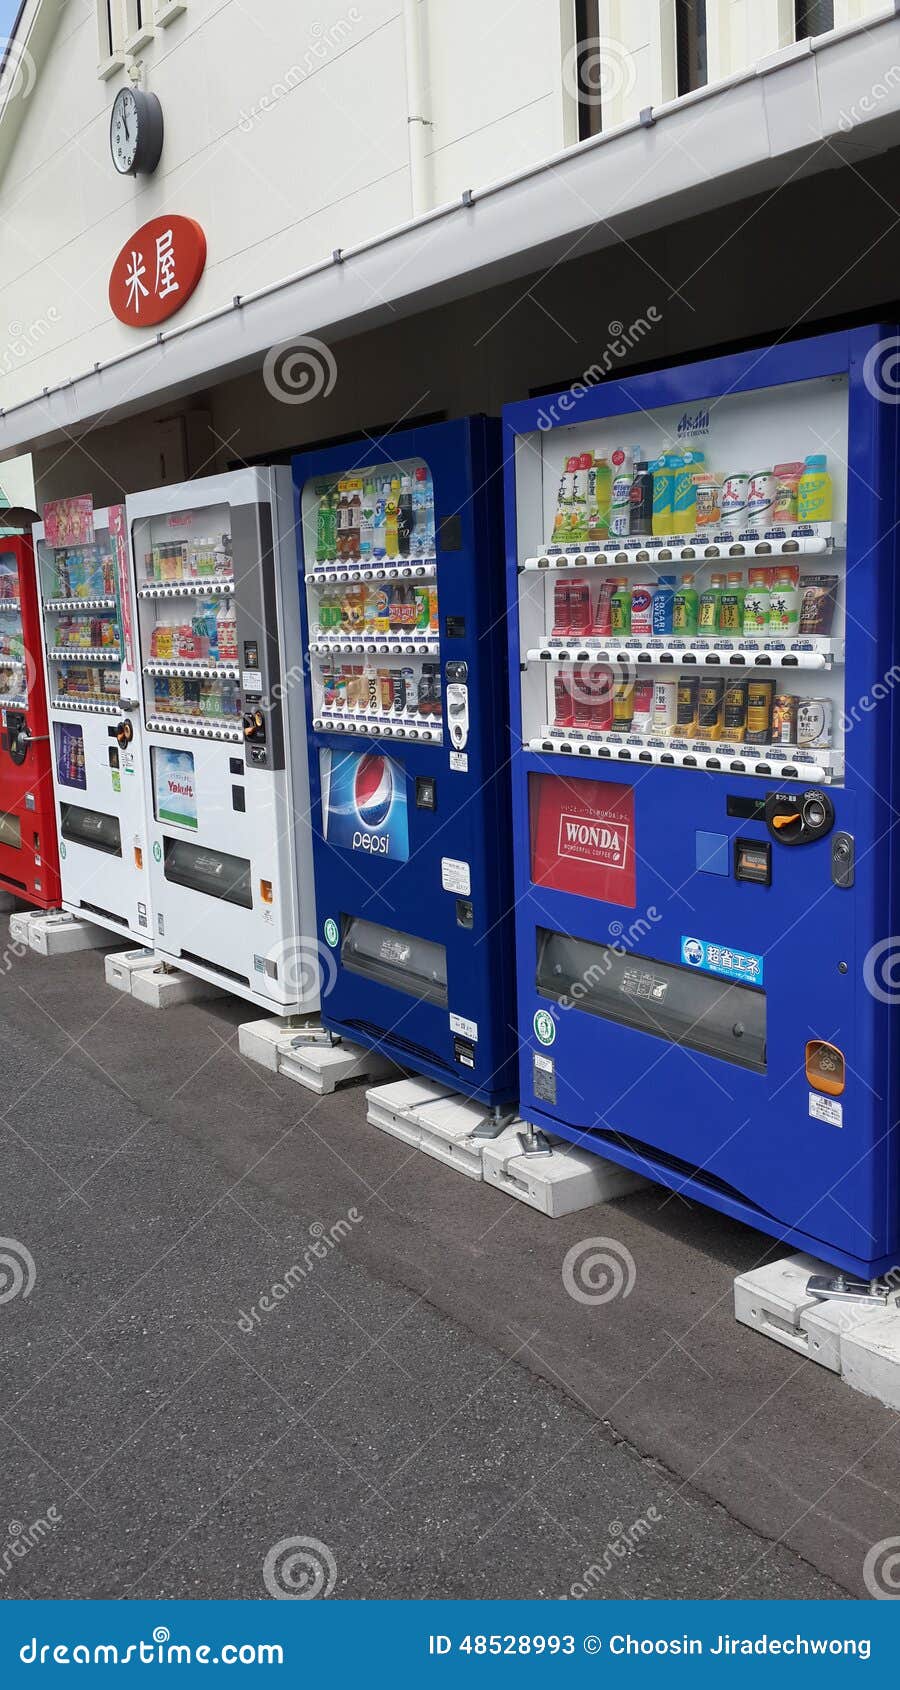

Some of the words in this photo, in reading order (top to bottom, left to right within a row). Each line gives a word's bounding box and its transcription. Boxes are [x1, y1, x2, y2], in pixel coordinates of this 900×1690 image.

[125, 229, 180, 314] 米屋
[677, 409, 710, 432] Asahi
[368, 679, 377, 708] BOSS
[168, 780, 193, 798] Yakult
[352, 831, 390, 854] pepsi
[566, 822, 621, 851] WONDA
[592, 849, 611, 859] COFFEE
[706, 944, 761, 976] 超省エネ
